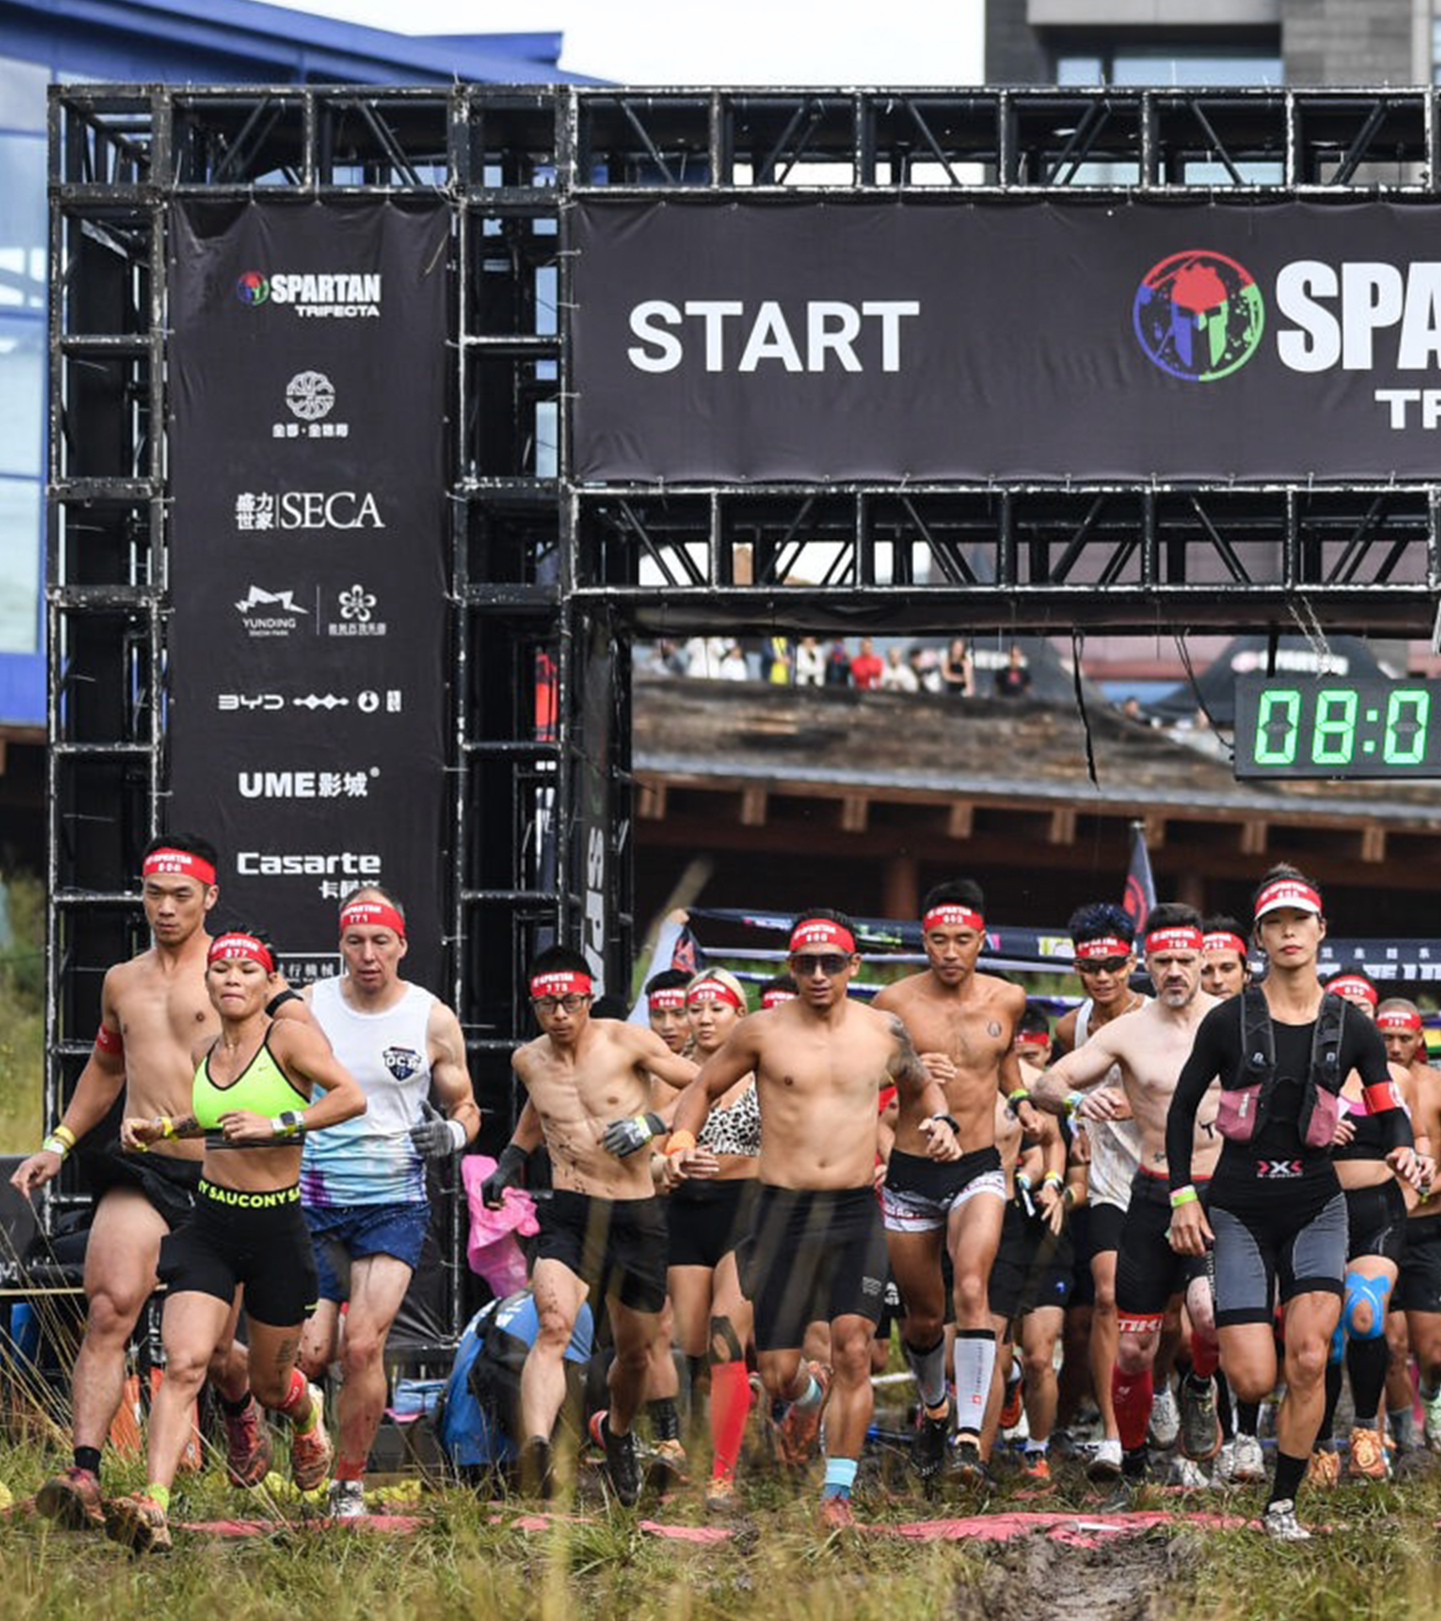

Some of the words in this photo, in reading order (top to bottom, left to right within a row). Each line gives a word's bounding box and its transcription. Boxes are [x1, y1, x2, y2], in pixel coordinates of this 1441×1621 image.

[270, 273, 381, 304] SPARTAN
[294, 304, 380, 318] TRIFECTA
[627, 299, 921, 373] START
[280, 491, 386, 530] SECA
[242, 617, 296, 630] YUNDING
[218, 694, 285, 710] BYD
[237, 852, 381, 875] Casarte
[208, 1186, 286, 1208] SAUCONY
